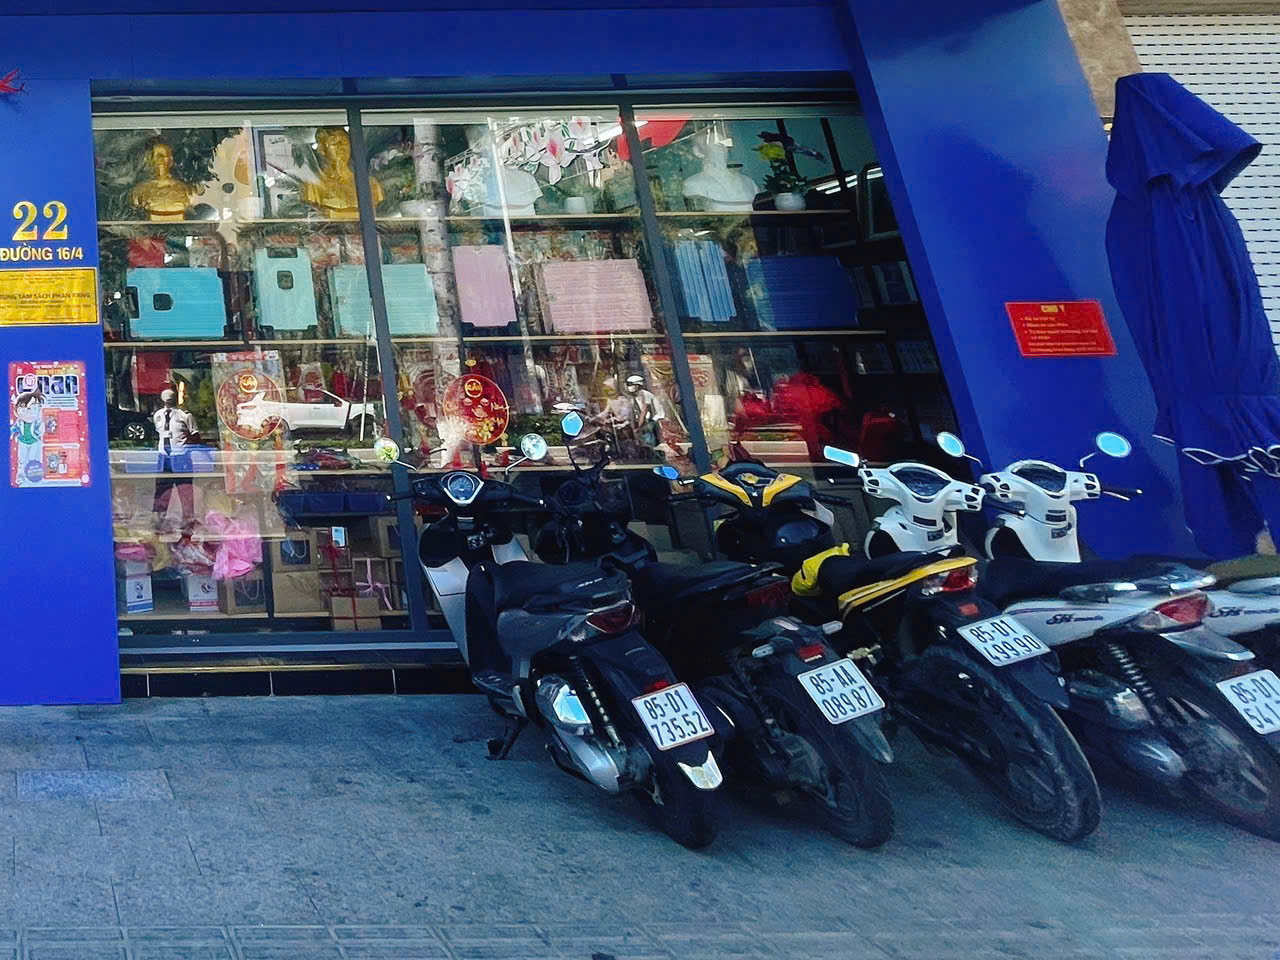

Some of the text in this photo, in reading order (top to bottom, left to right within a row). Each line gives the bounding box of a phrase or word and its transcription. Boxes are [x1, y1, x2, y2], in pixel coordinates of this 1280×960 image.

[11, 200, 68, 241] 22
[0, 242, 84, 262] ĐƯỜNG 16/4
[983, 634, 1042, 662] 499.90
[808, 665, 858, 695] 85-AA
[821, 685, 874, 719] 089.87
[650, 710, 709, 746] 735.52
